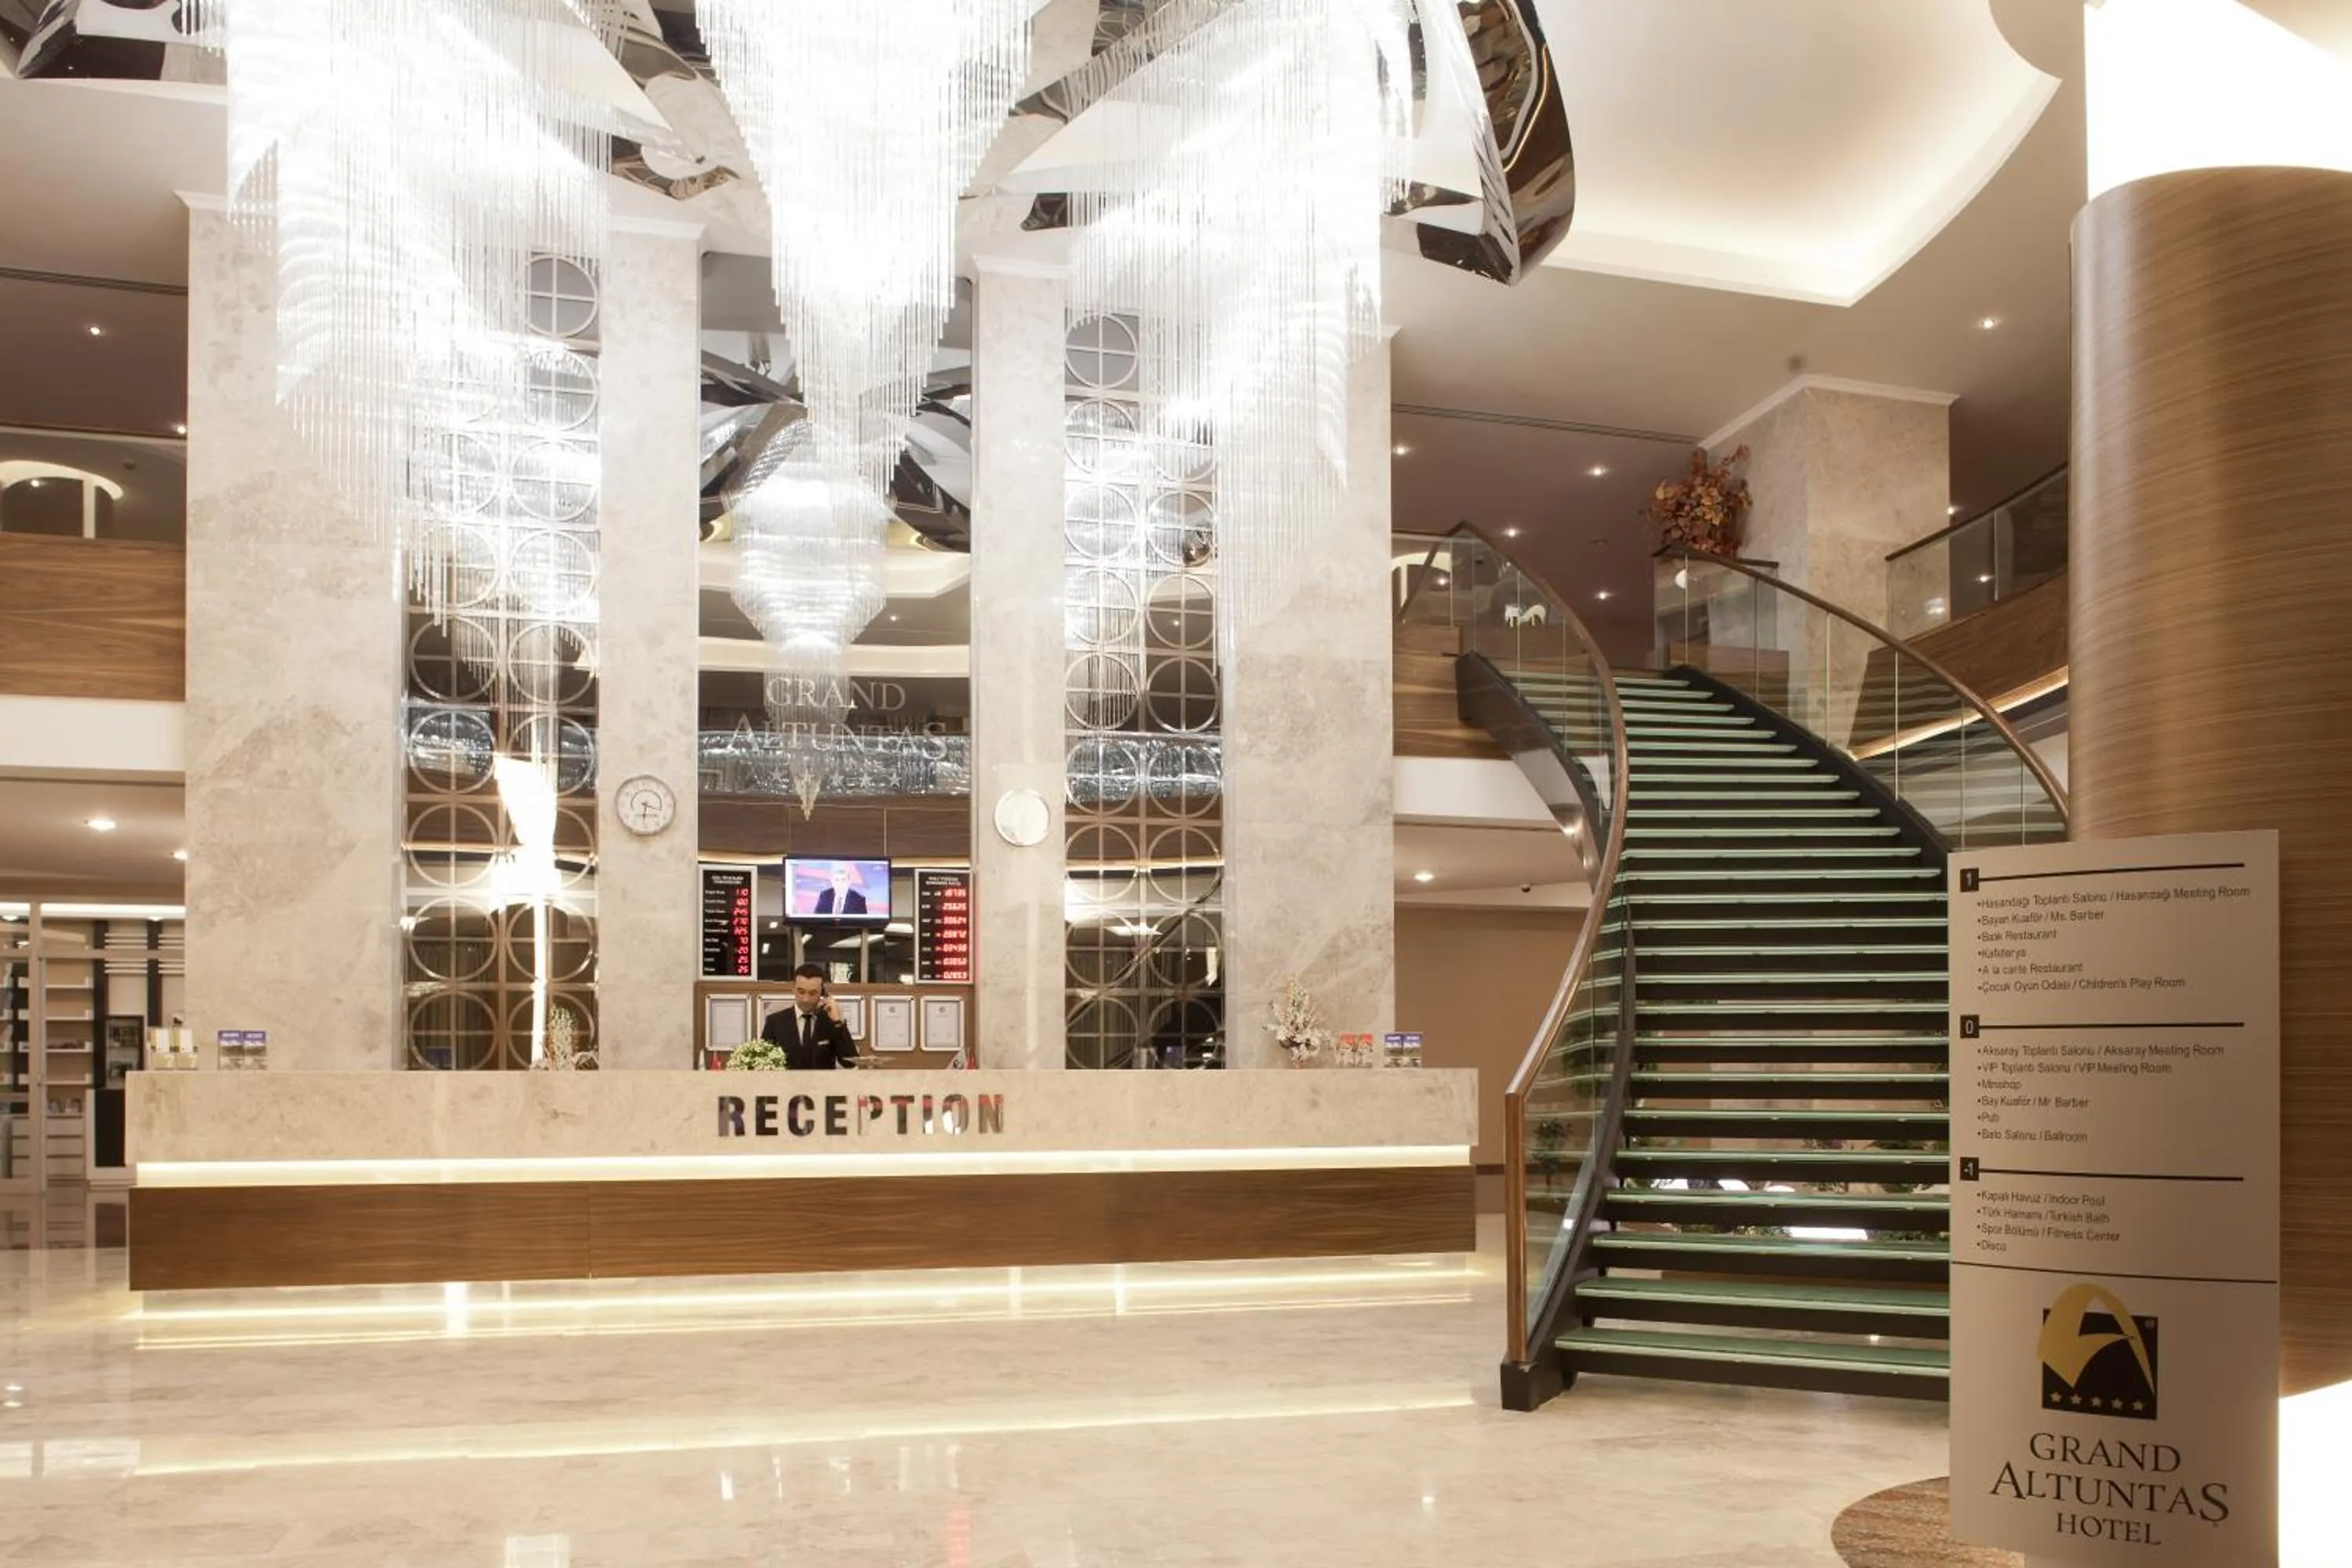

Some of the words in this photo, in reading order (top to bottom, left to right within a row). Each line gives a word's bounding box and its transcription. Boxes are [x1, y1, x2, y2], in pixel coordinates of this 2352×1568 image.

[766, 676, 906, 710] GRAND
[1965, 871, 1973, 887] 1
[2072, 892, 2107, 903] Salonu
[2173, 887, 2216, 899] Meeting
[2218, 886, 2251, 897] Room
[1982, 915, 2009, 927] Bayan
[2070, 909, 2105, 920] Barber
[2005, 928, 2057, 940] Restaurant
[2002, 964, 2027, 975] carte
[2031, 963, 2083, 974] Restaurant
[1982, 981, 2009, 994] Çocuk
[2014, 980, 2038, 993] Oyun
[2130, 978, 2152, 990] Play
[2154, 976, 2186, 988] Room
[1965, 1019, 1973, 1035] 0
[1982, 1044, 2019, 1058] Aksaray
[2060, 1044, 2095, 1056] Salonu
[2103, 1044, 2147, 1058] Aksaray
[2148, 1044, 2190, 1058] Meeting
[2193, 1044, 2224, 1055] Room
[1983, 1062, 1998, 1073] VIP
[2038, 1062, 2071, 1073] Salonu
[2079, 1062, 2095, 1073] VIP
[2097, 1062, 2137, 1075] Meeting
[2140, 1062, 2172, 1073] Room
[1982, 1095, 1998, 1108] Bay
[2055, 1098, 2088, 1109] Barber
[717, 1094, 1004, 1137] RECEPTION
[1982, 1111, 1999, 1123] Pub
[2005, 1129, 2037, 1141] Salonu
[2045, 1130, 2088, 1142] Ballroom
[1963, 1162, 1974, 1177] -1
[2011, 1192, 2041, 1203] Havuz
[2049, 1192, 2080, 1205] Indoor
[2082, 1194, 2105, 1207] Pool
[1982, 1206, 2001, 1217] Türk
[2048, 1210, 2083, 1222] Turkish
[2085, 1212, 2110, 1224] Bath
[1981, 1222, 2002, 1236] Spor
[2047, 1227, 2083, 1240] Fitness
[2086, 1229, 2121, 1242] Center
[1981, 1240, 2007, 1253] Disco
[2029, 1432, 2181, 1473] GRAND
[2055, 1512, 2161, 1546] HOTEL
